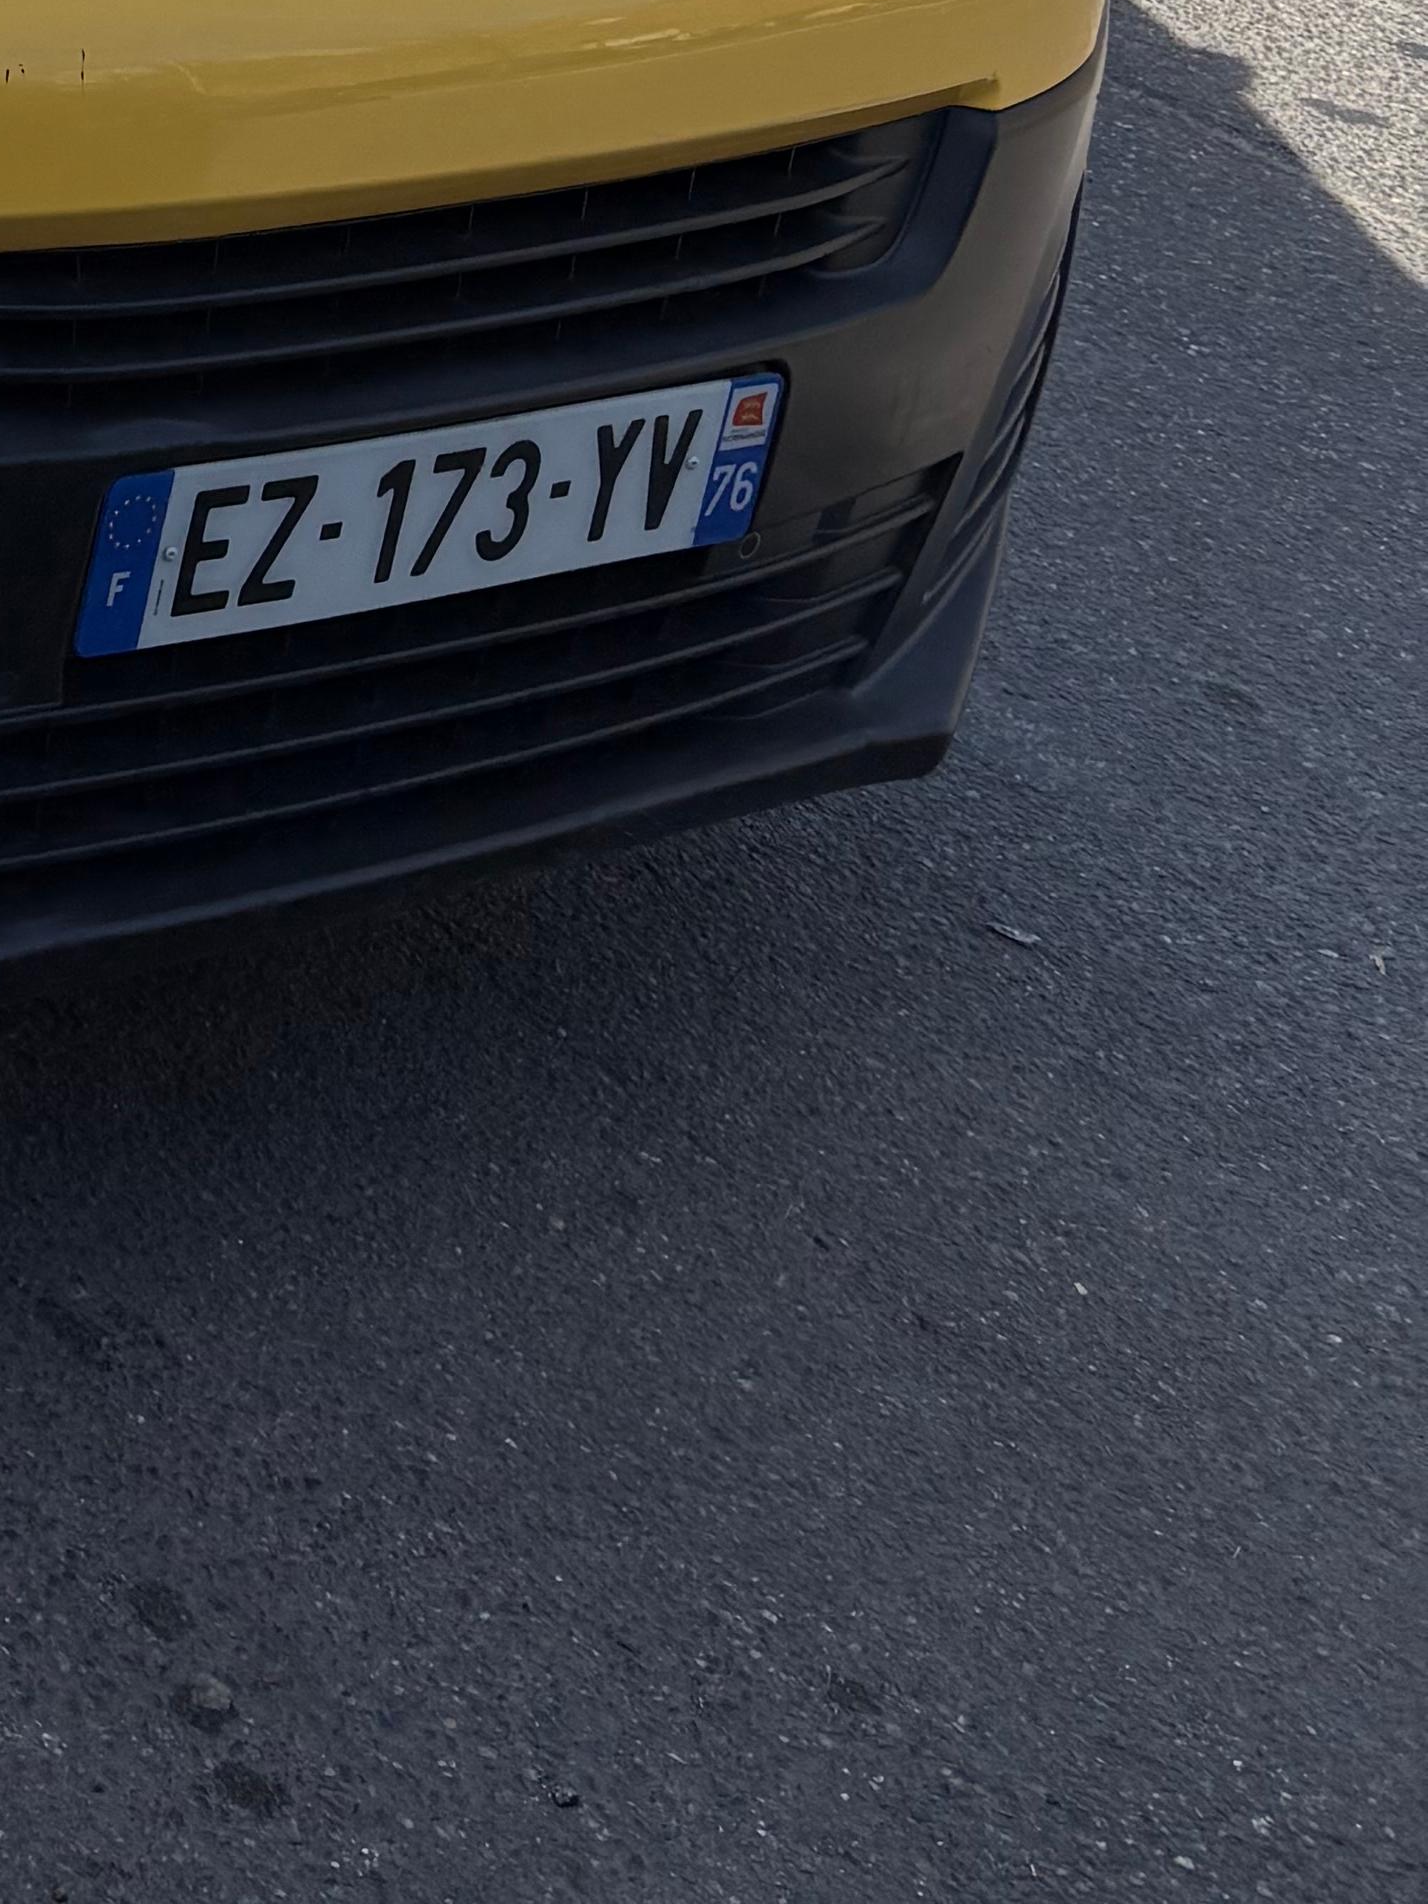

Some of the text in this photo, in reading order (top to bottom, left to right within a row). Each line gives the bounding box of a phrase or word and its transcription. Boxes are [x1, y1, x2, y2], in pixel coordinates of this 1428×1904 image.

[170, 409, 703, 617] EZ-173-YV
[704, 461, 758, 517] 76
[106, 571, 131, 607] F
